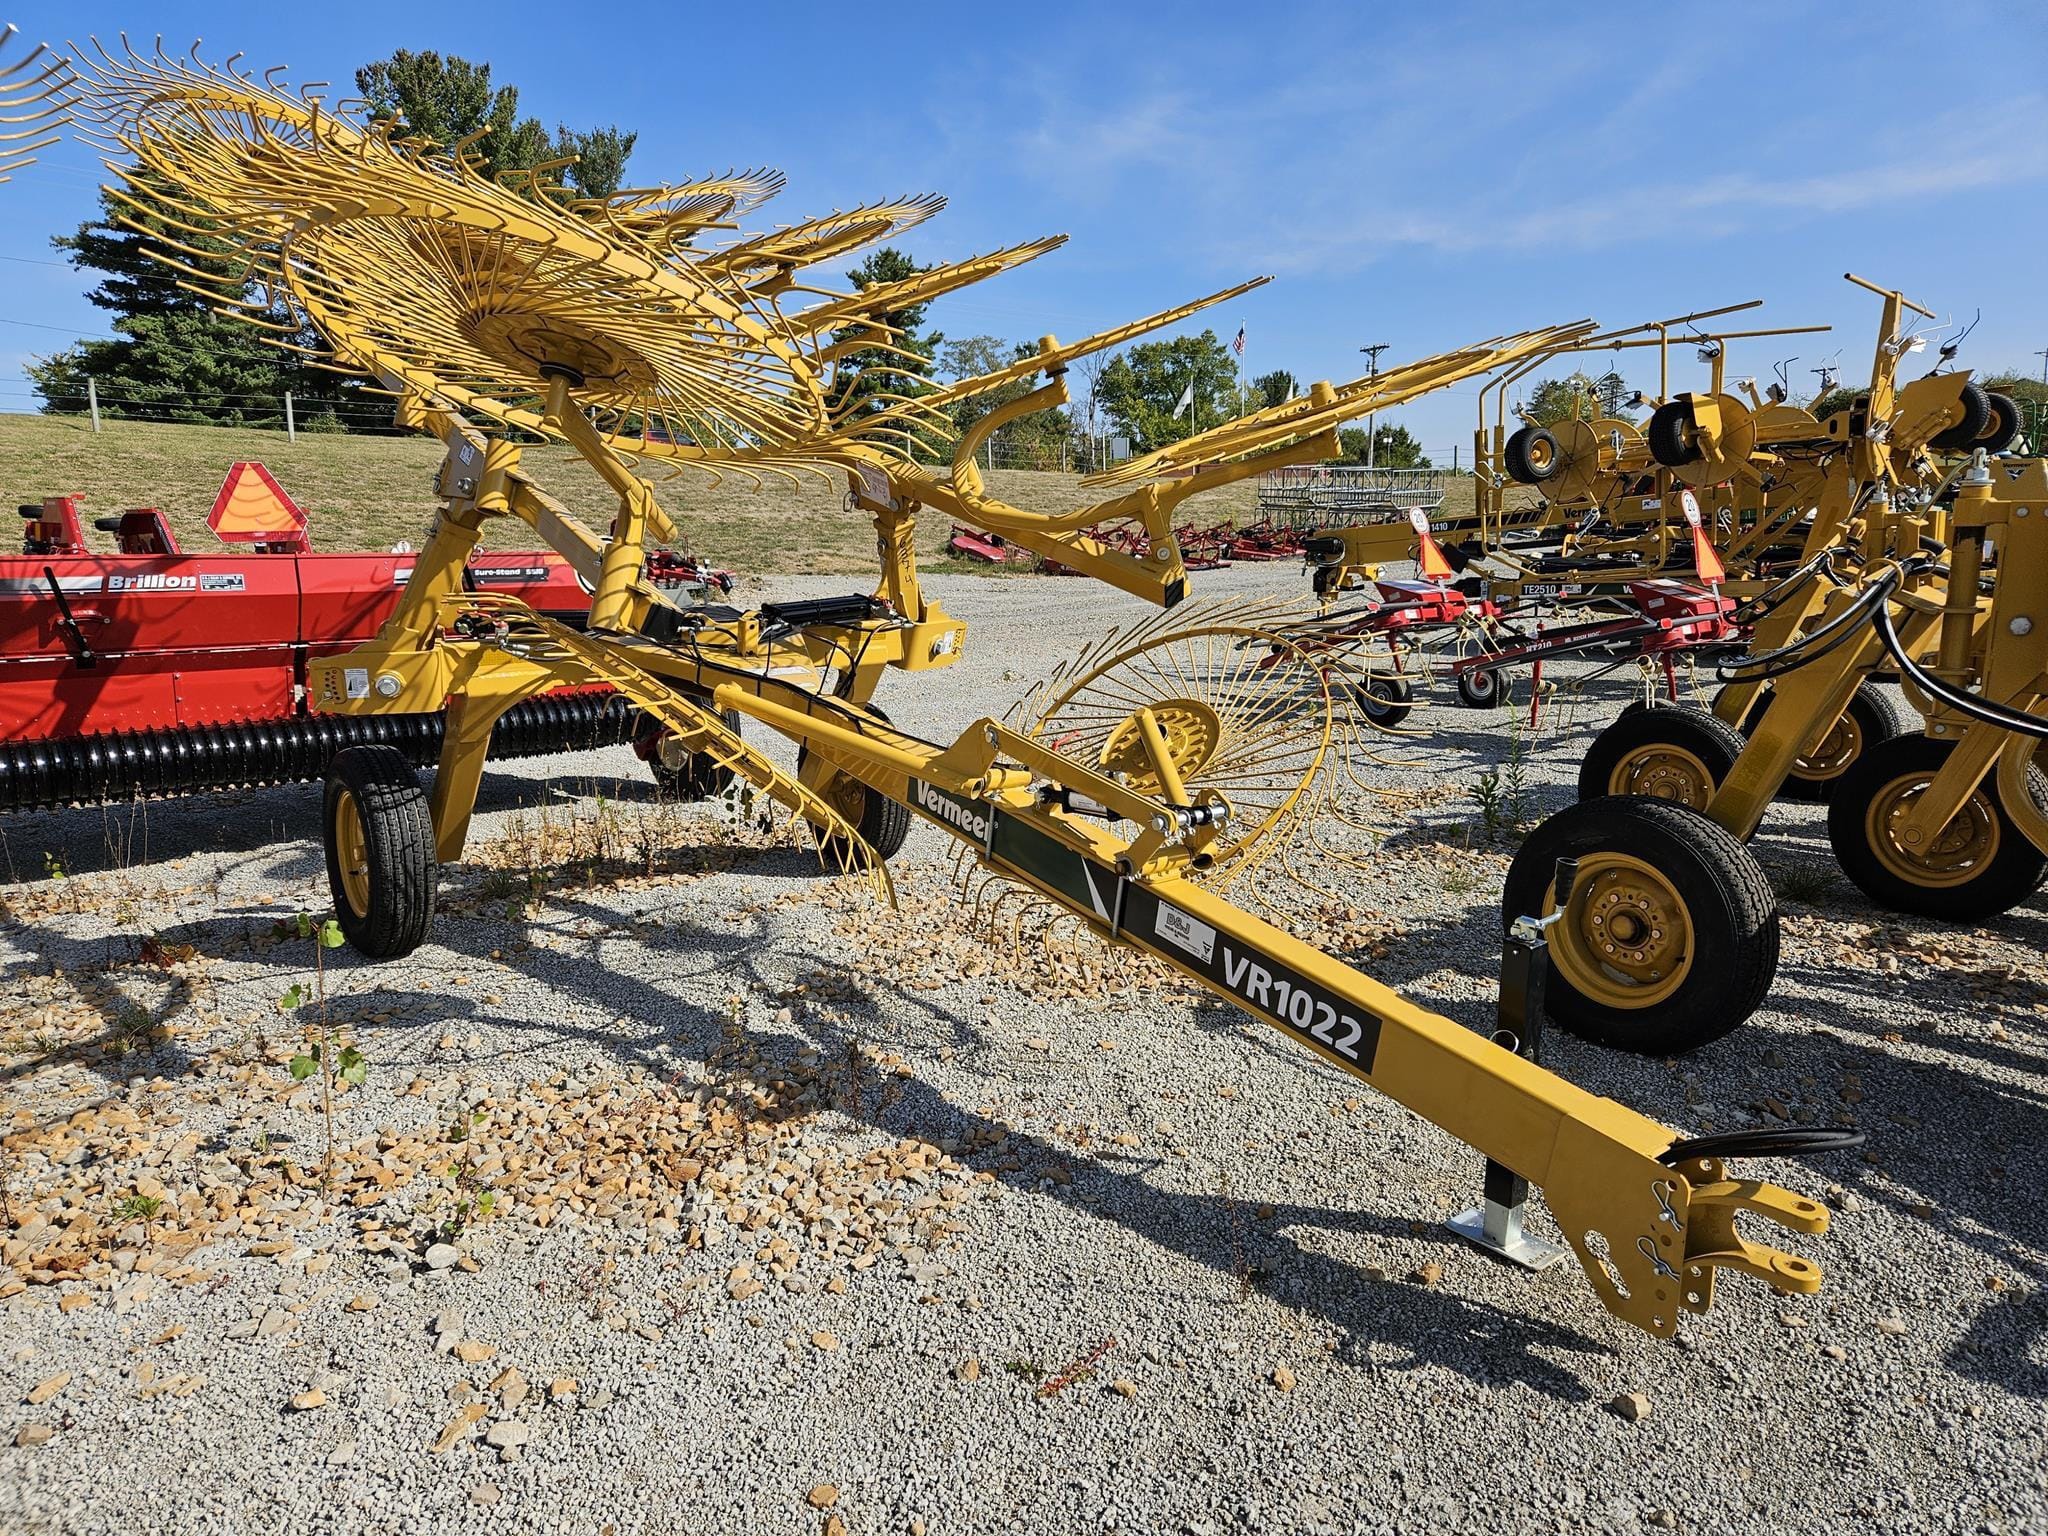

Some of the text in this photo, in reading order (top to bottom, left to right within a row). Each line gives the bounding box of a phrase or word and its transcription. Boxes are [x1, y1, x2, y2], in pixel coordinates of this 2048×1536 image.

[1413, 511, 1424, 523] 20
[1431, 523, 1448, 532] 1410
[108, 574, 196, 589] Brillion
[1523, 585, 1557, 595] TE2510
[1166, 912, 1191, 935] D&J
[1223, 947, 1362, 1060] VR1022
